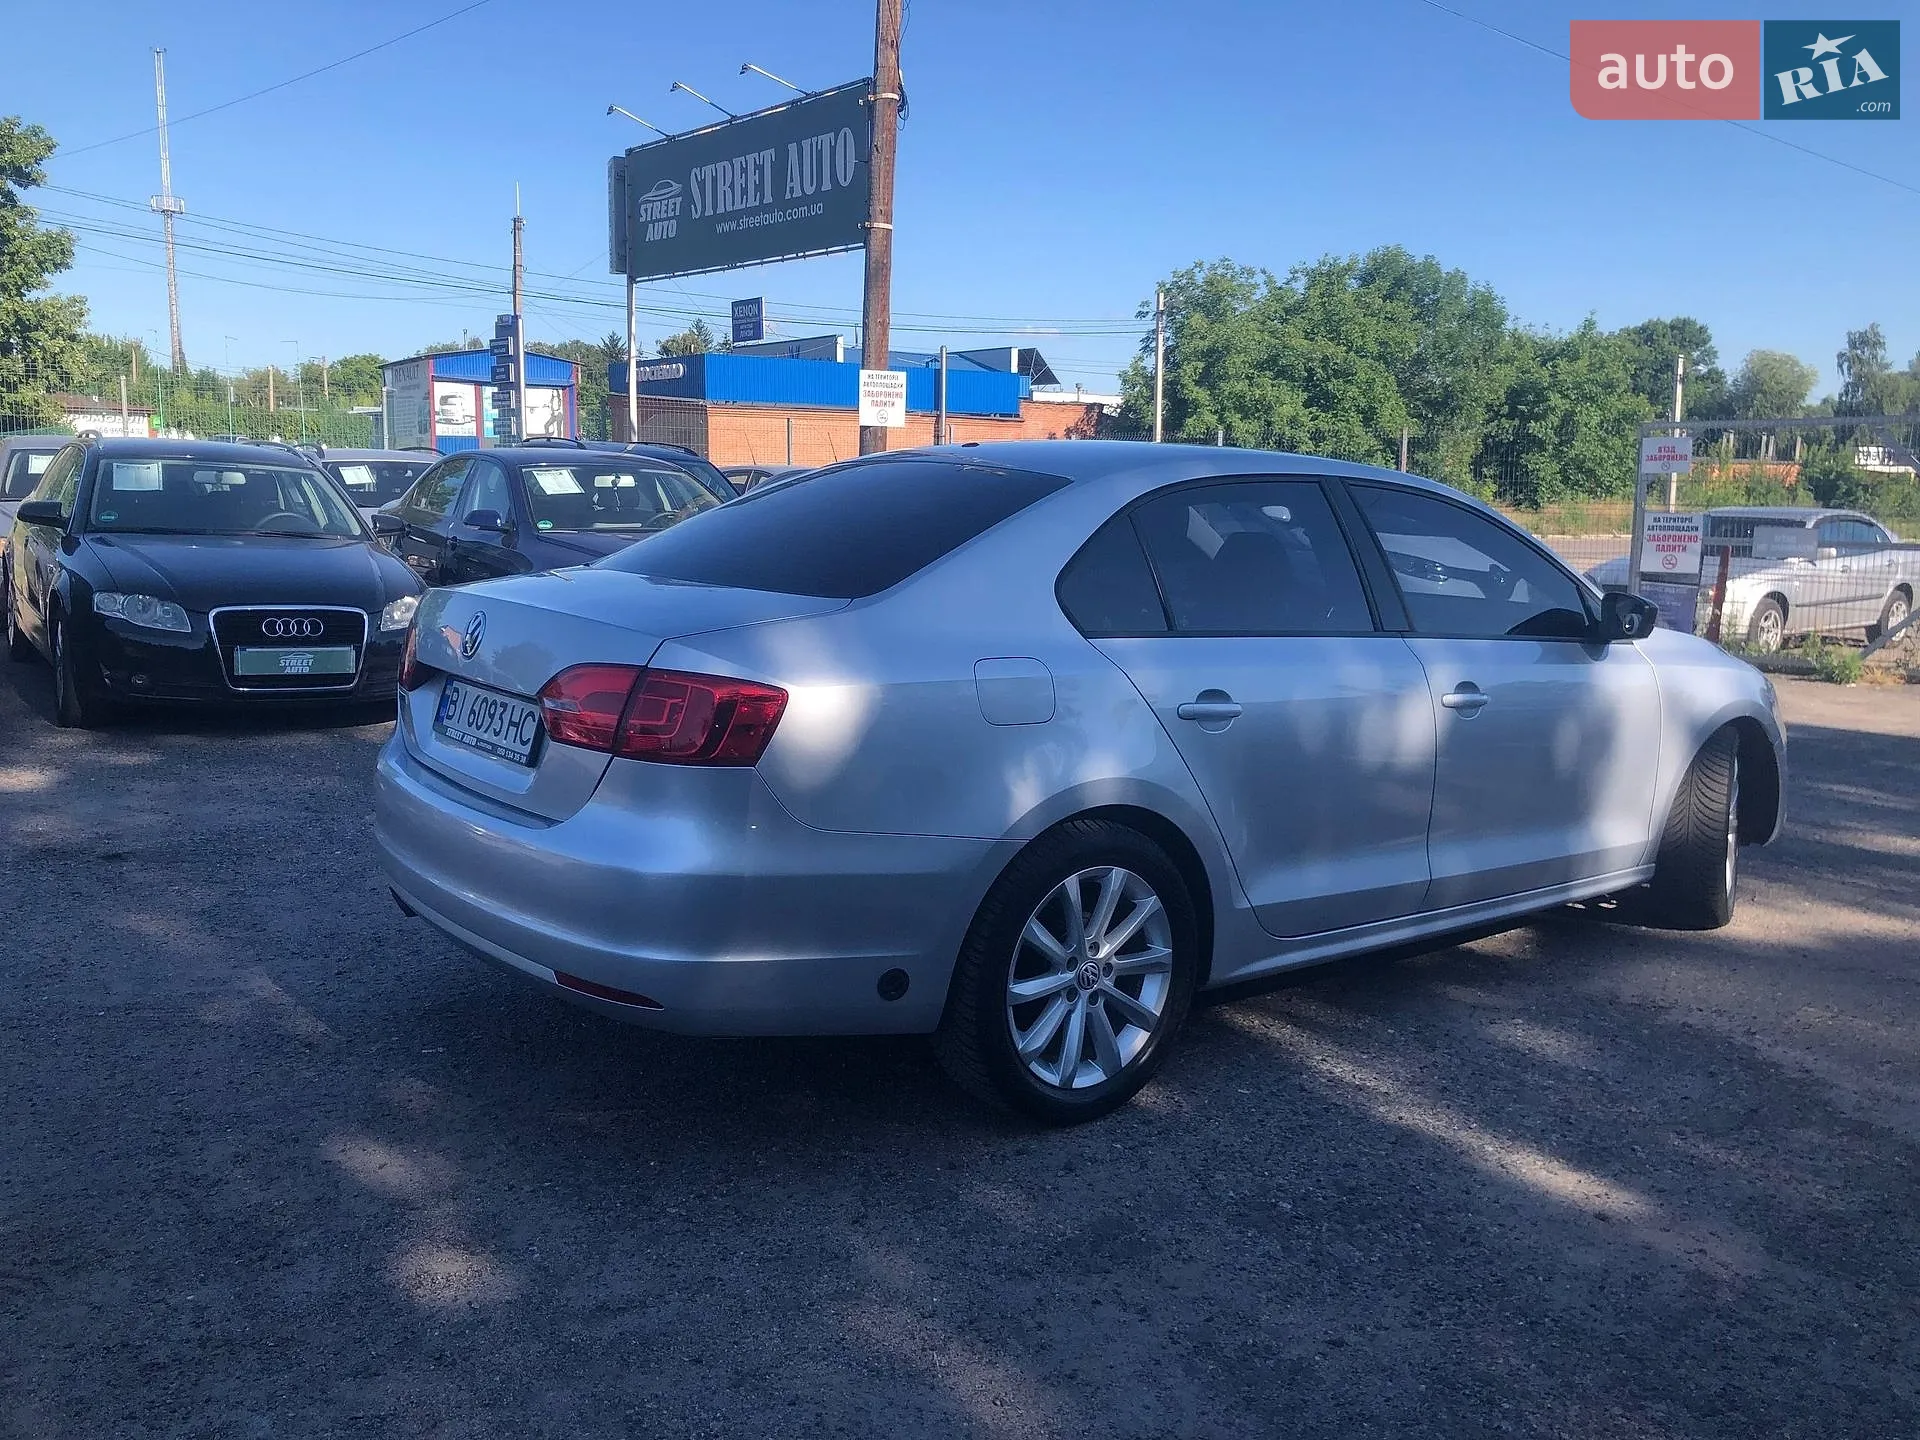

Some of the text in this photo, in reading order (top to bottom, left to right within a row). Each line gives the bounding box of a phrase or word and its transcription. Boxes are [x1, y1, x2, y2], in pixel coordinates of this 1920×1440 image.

[690, 127, 856, 220] STREET AUTO
[639, 196, 683, 222] STREET
[715, 201, 824, 234] www.streetauto.com.ua
[645, 219, 677, 242] AUTO
[733, 303, 759, 318] XENON
[1646, 532, 1699, 543] ЗАБОРОНЕНО
[1655, 543, 1688, 553] ПАЛИТИ
[279, 658, 314, 667] STREET
[284, 666, 310, 674] AUTO
